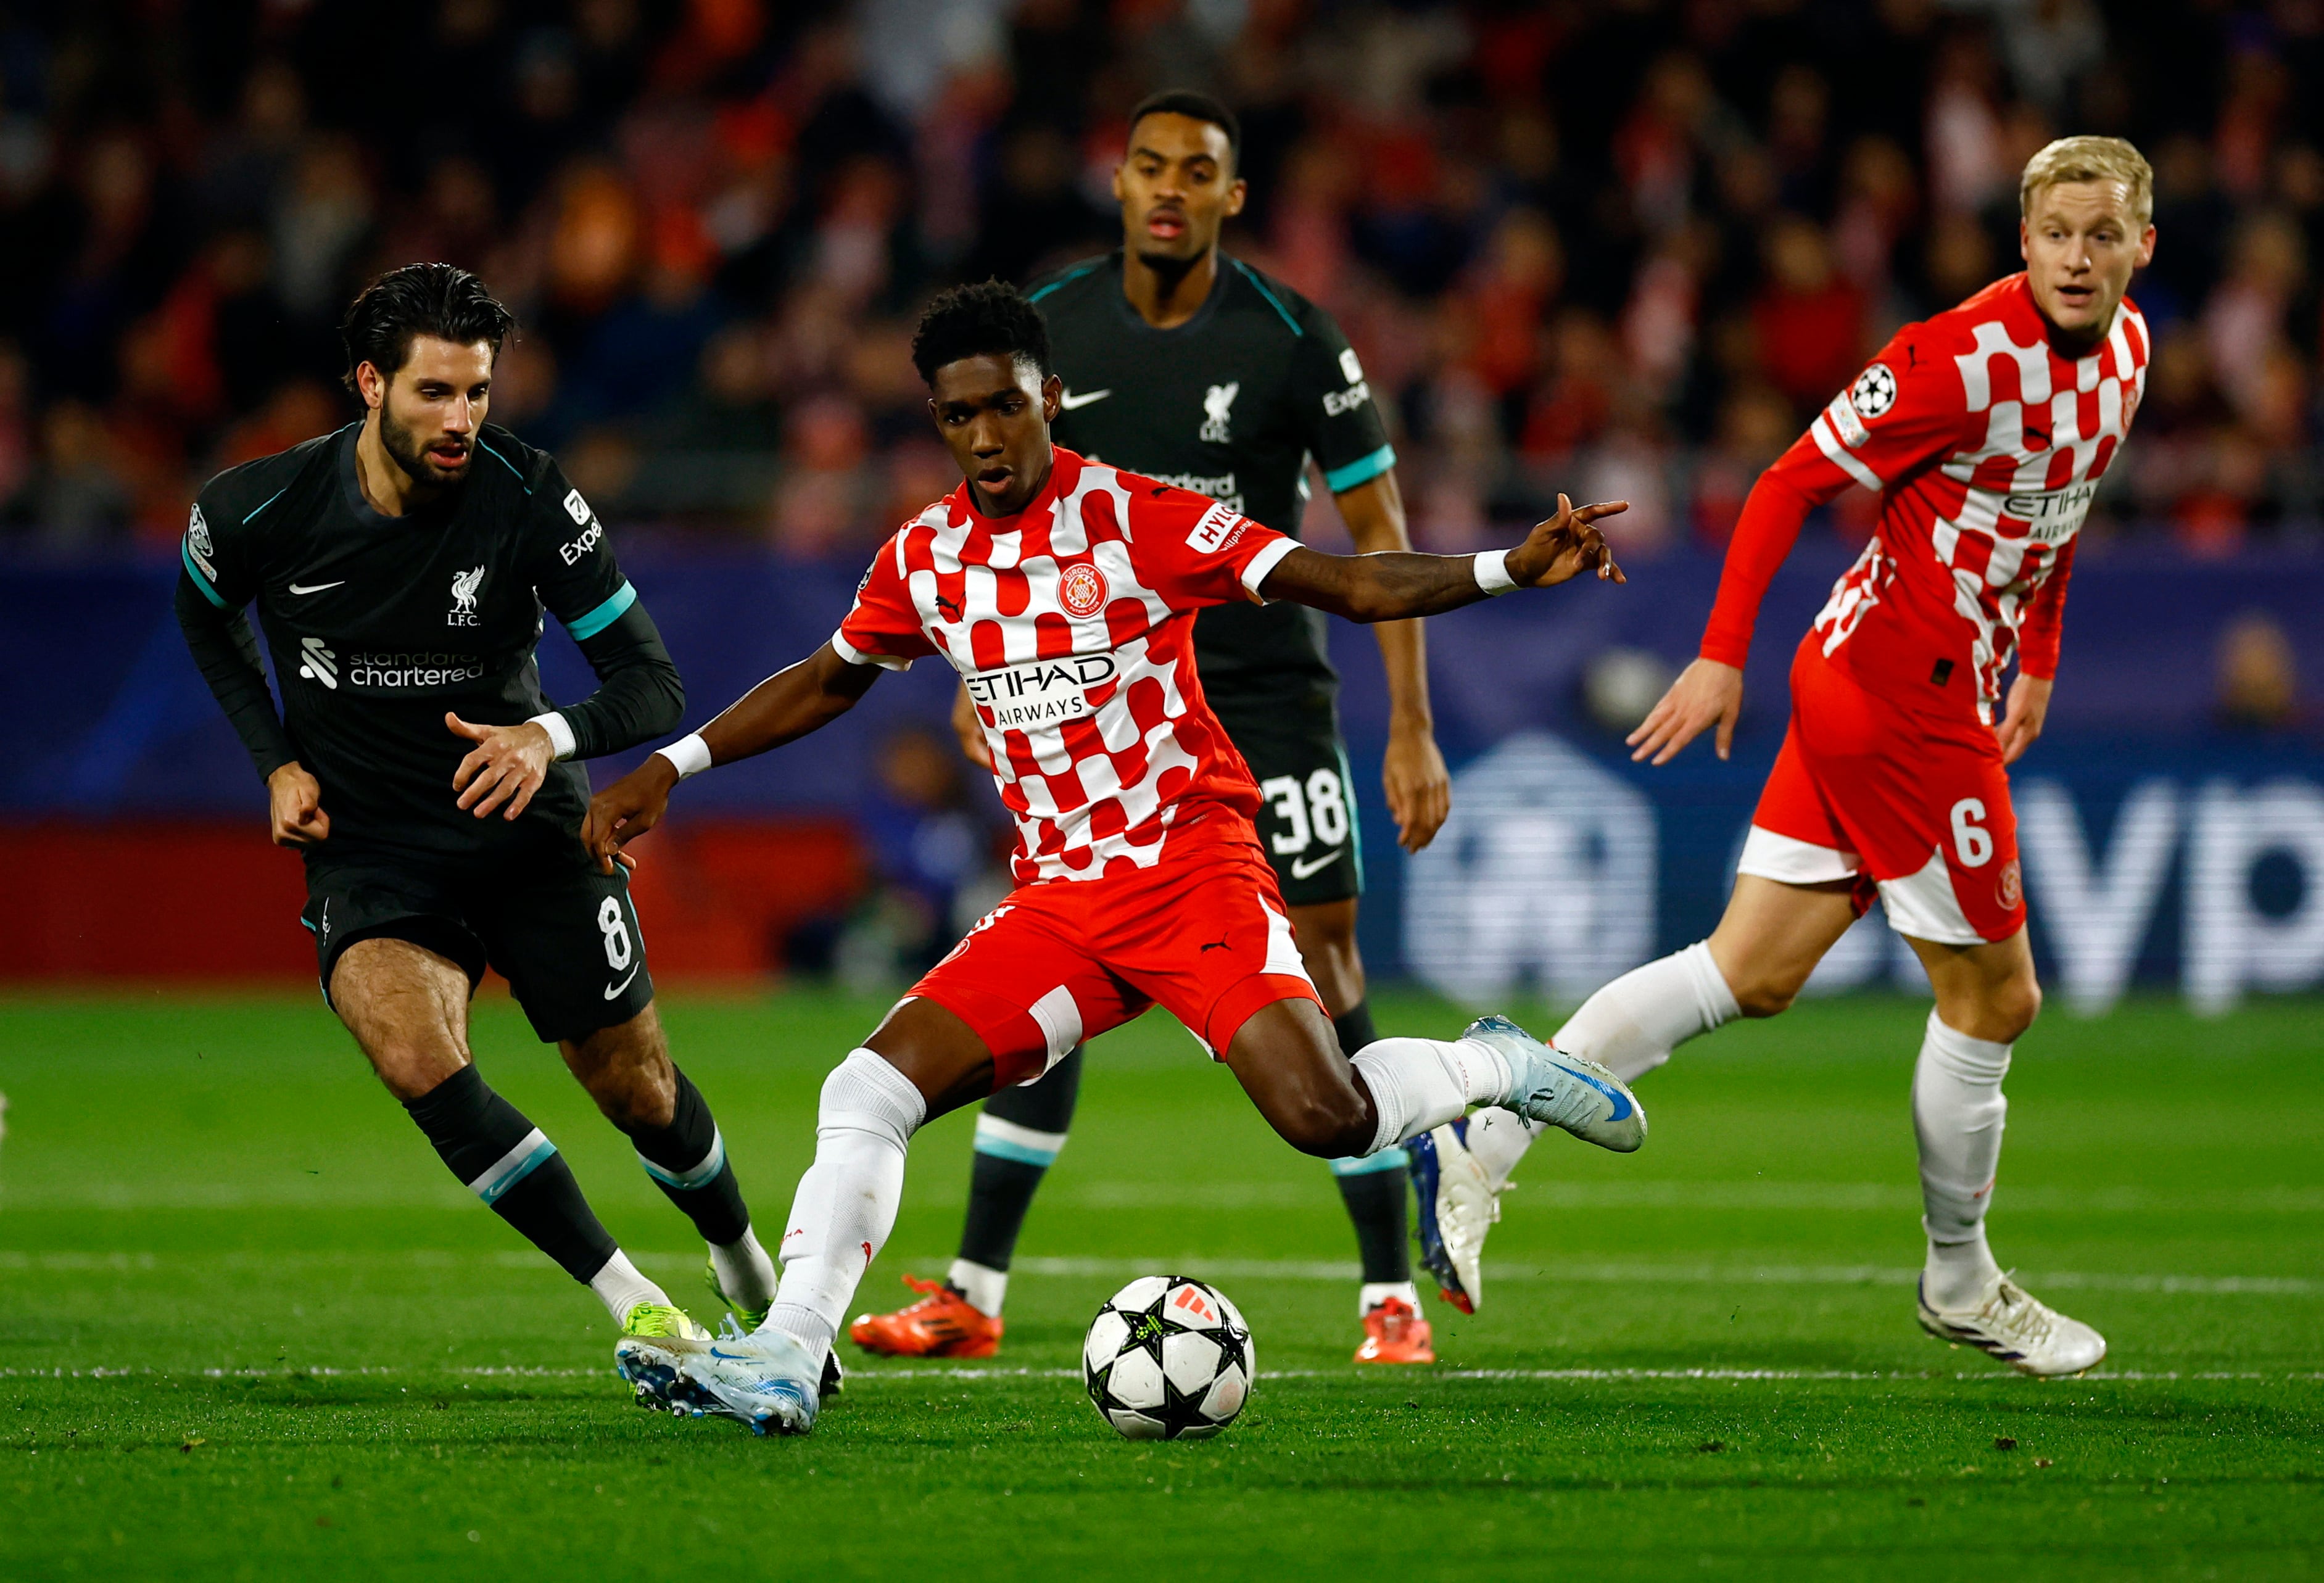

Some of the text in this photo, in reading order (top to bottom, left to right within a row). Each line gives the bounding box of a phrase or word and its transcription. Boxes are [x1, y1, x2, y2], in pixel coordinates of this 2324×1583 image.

[559, 510, 602, 566] Expe
[1064, 567, 1095, 581] GIRONA
[447, 613, 481, 626] L.F.C.
[1088, 601, 1099, 611] CLUB
[350, 663, 483, 687] chartered
[966, 656, 1115, 701] ETIHAD
[999, 696, 1082, 725] AIRWAYS
[1260, 767, 1349, 855] 38
[1950, 797, 1993, 868] 6
[597, 895, 632, 971] 8
